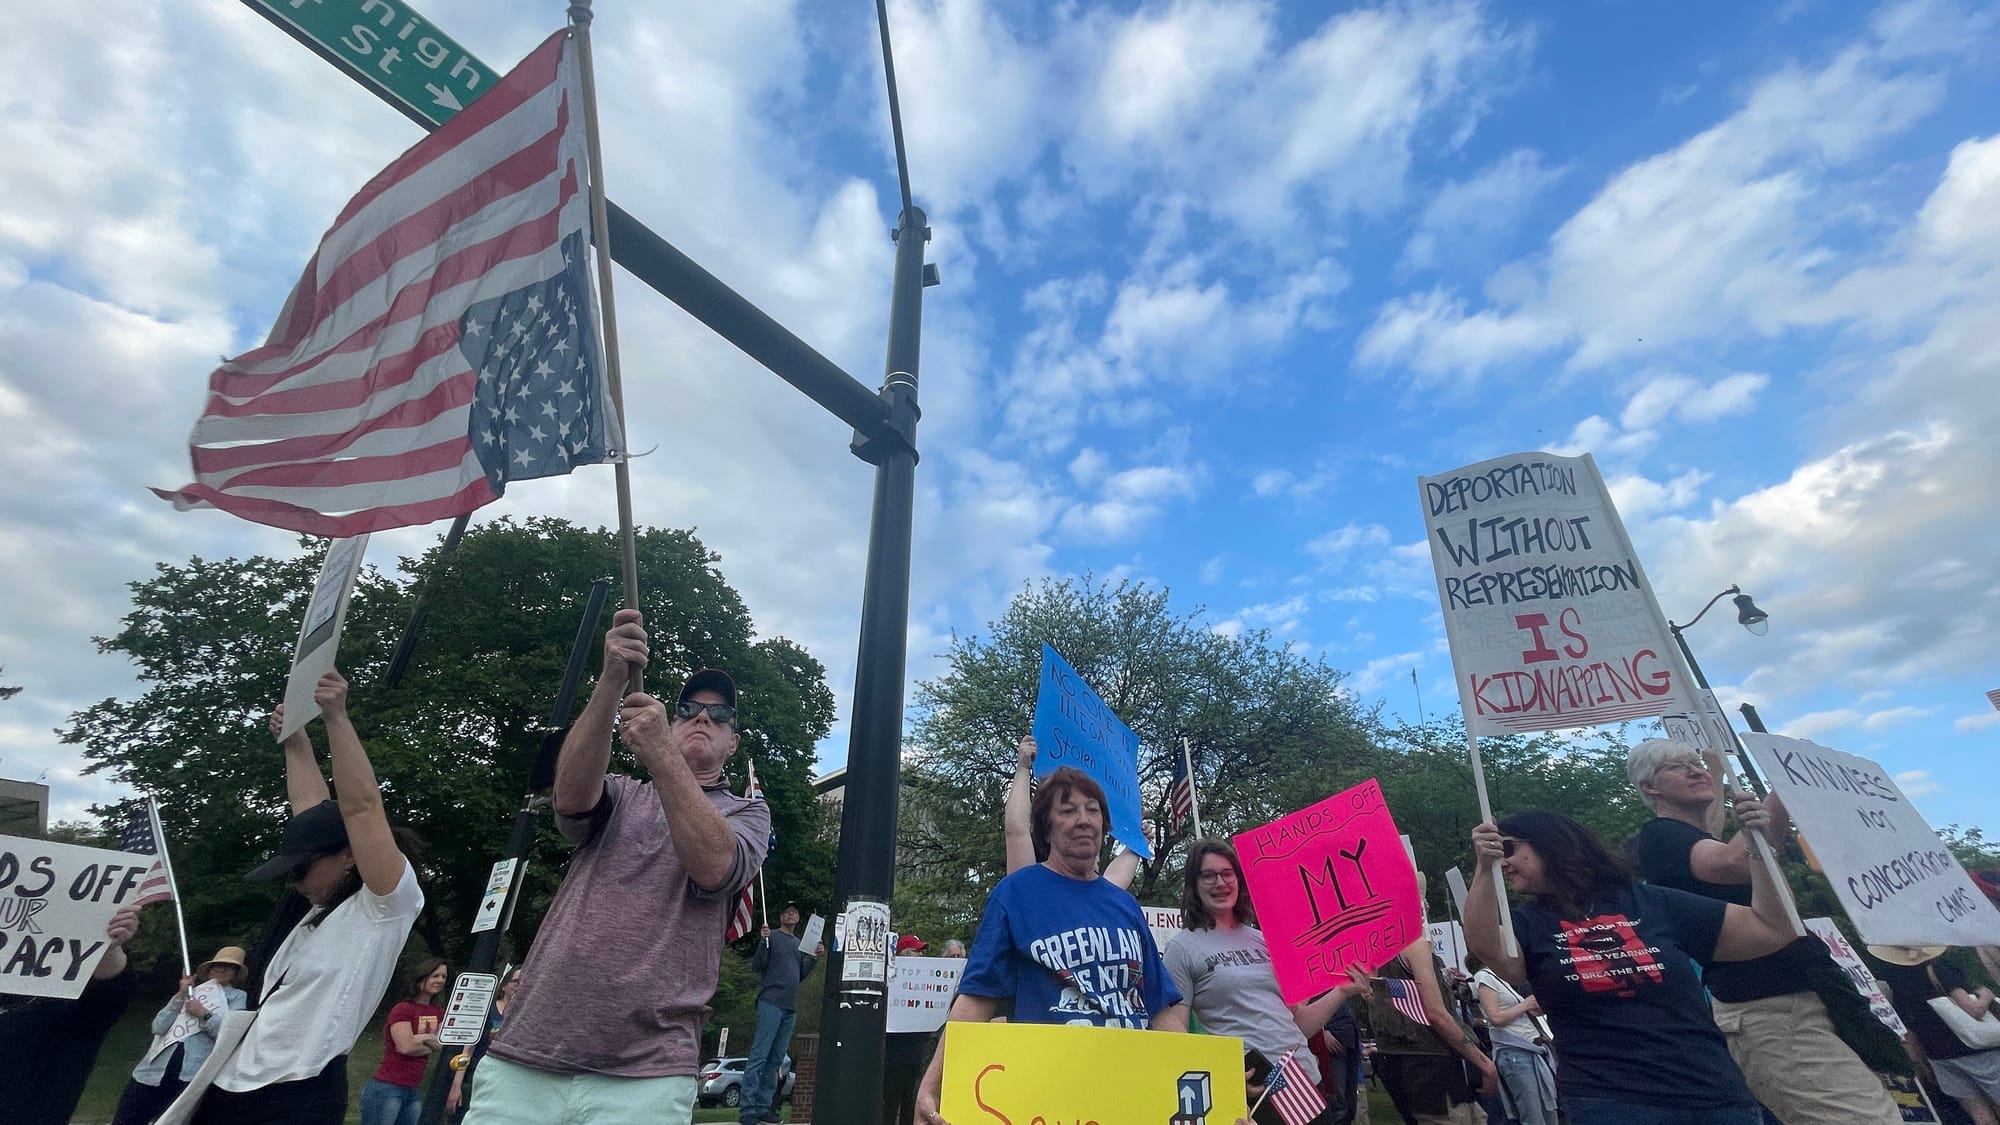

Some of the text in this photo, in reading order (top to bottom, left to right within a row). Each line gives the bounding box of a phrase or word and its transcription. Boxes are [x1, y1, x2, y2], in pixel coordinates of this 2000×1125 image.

[341, 24, 402, 75] St
[1426, 462, 1576, 517] DEPORTATION
[1436, 516, 1592, 568] WITHOUT
[1515, 607, 1588, 664] IS
[1471, 649, 1671, 715] KIDNAPPING
[1049, 727, 1096, 770] Stolen
[1255, 785, 1377, 857] HANDS OFF
[1856, 807, 1896, 831] NOT
[69, 863, 148, 904] OFF
[1297, 837, 1379, 929] MY
[1306, 916, 1406, 984] FUTURE!
[1560, 953, 1603, 965] MASSES
[1605, 946, 1661, 961] YEARNING
[1564, 963, 1665, 982] TO BREATHE FREE
